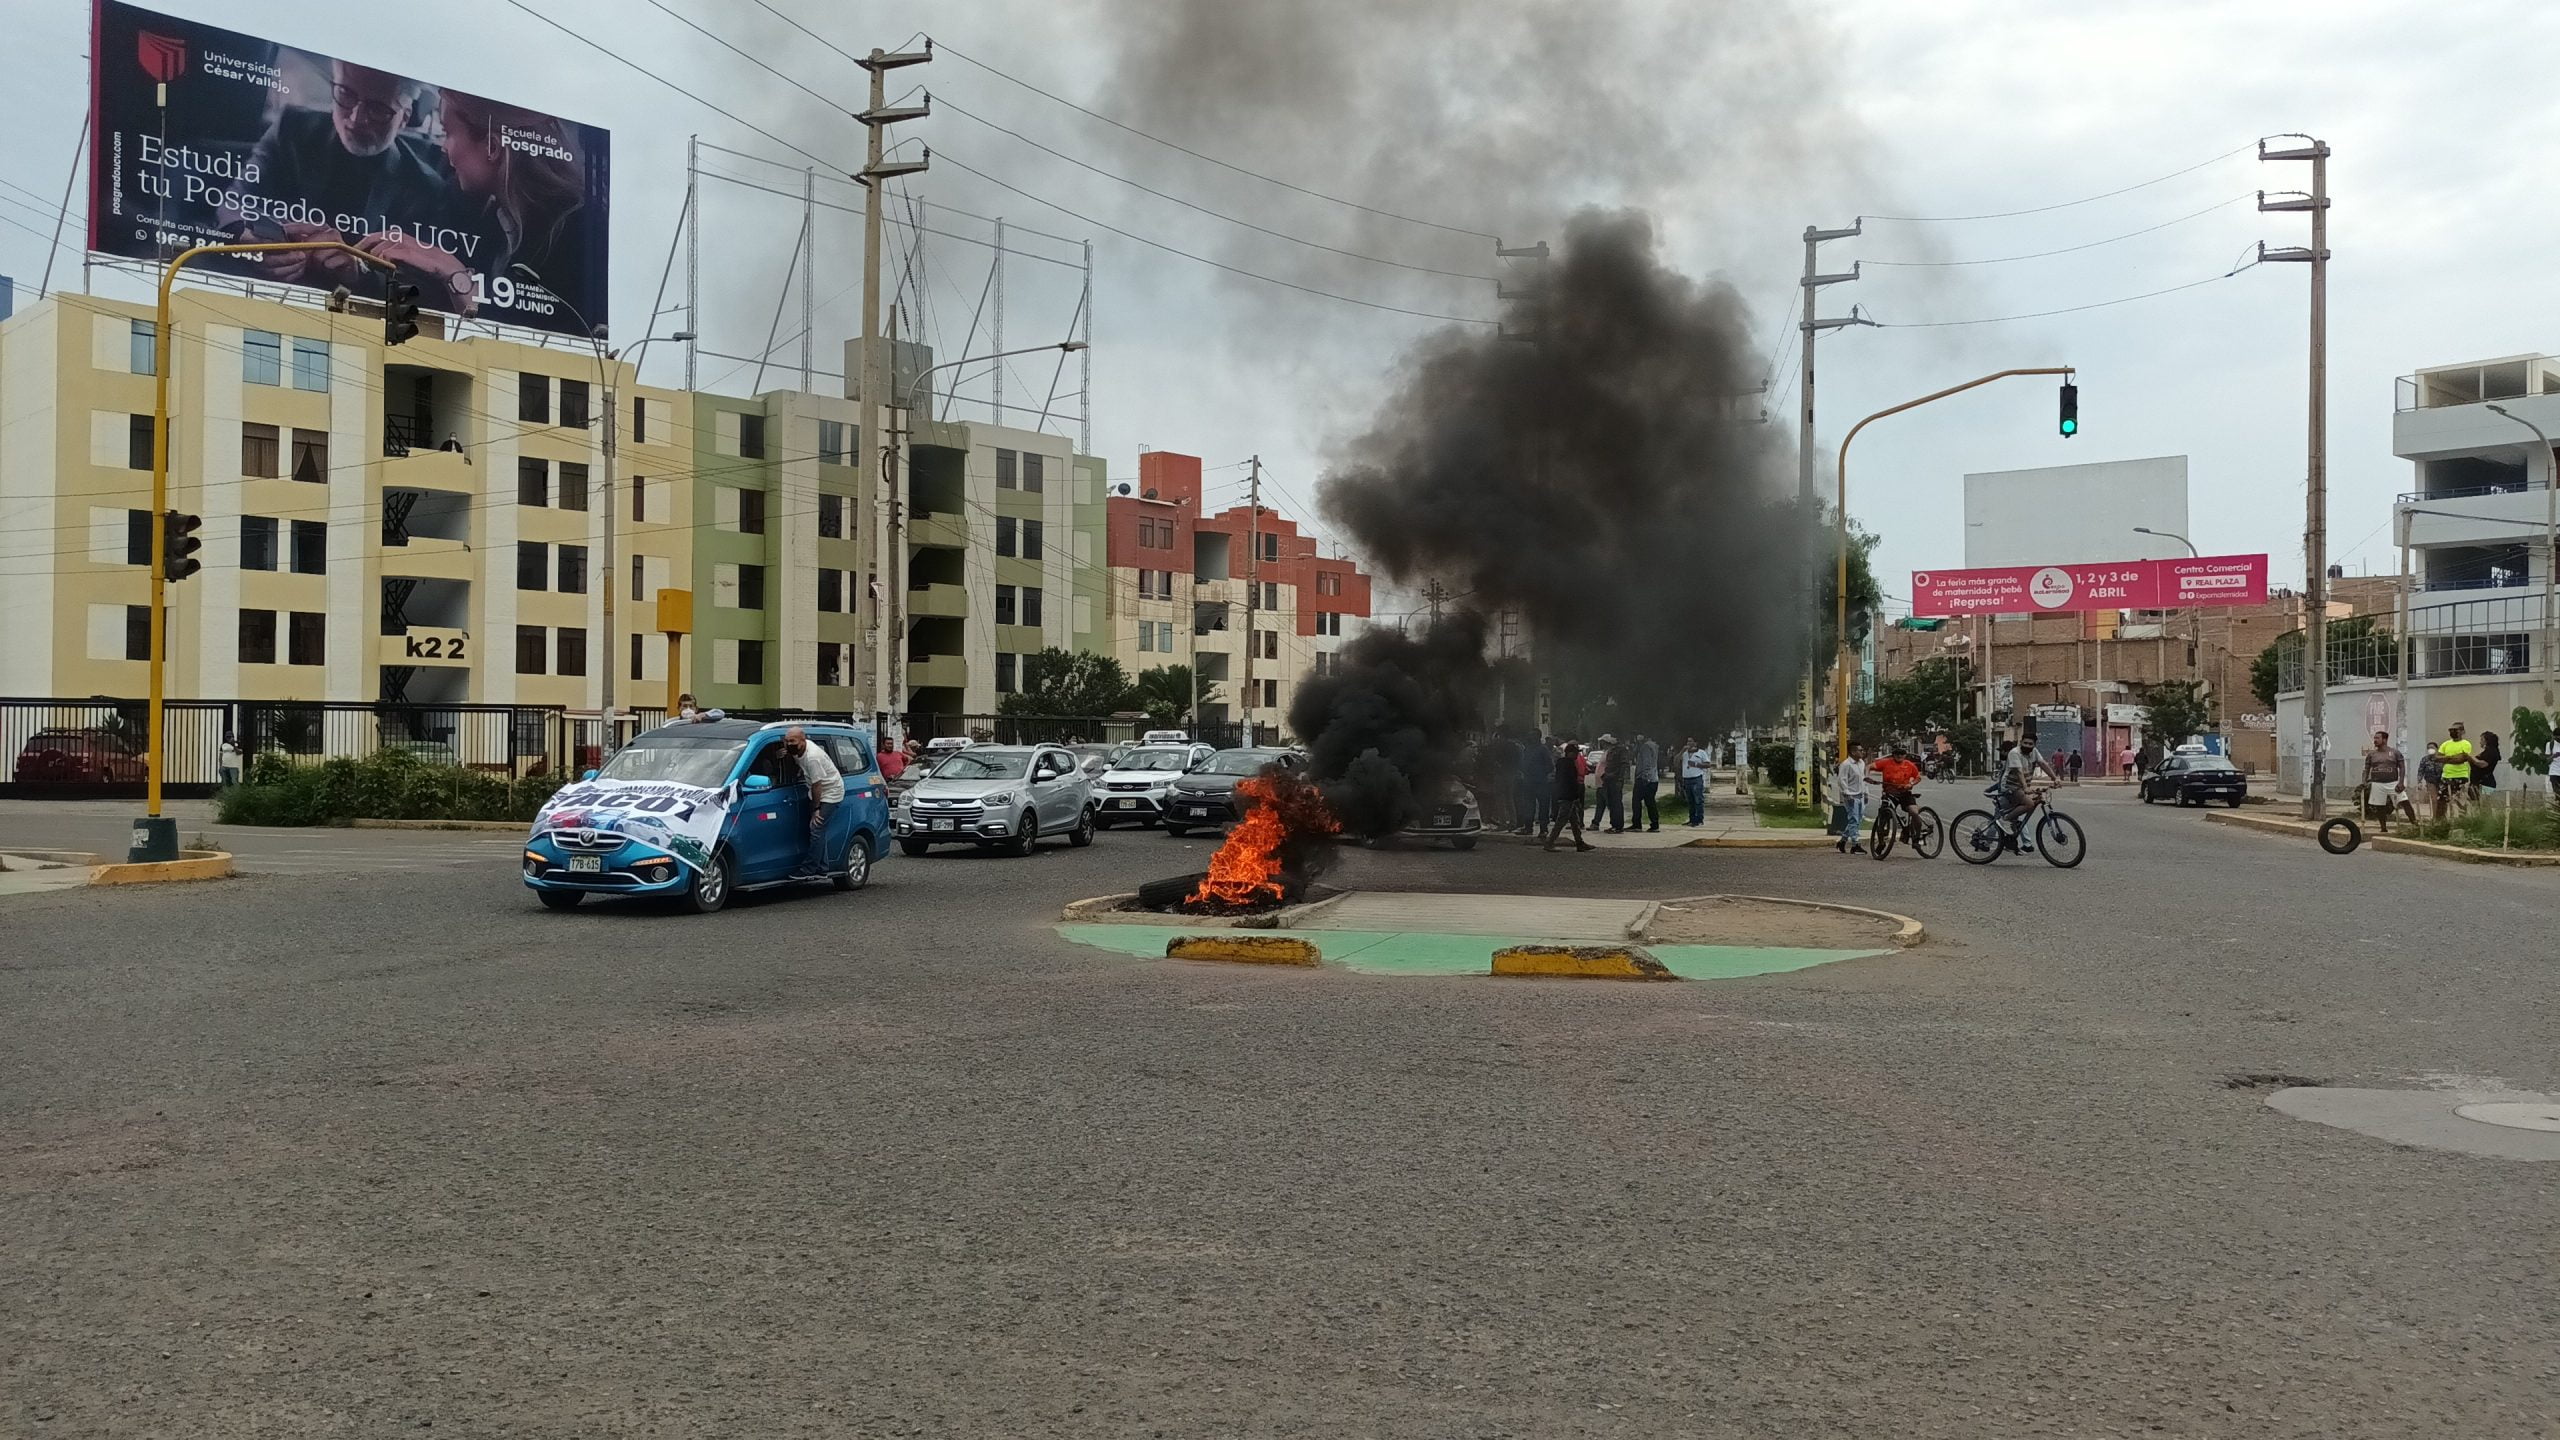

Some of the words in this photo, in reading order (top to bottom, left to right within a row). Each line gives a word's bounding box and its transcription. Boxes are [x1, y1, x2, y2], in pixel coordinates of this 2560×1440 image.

[204, 49, 281, 77] Universidad
[203, 63, 244, 80] César
[246, 73, 290, 94] Vallejo
[501, 124, 542, 142] Escuela
[544, 134, 557, 145] de
[139, 134, 260, 184] Estudia
[501, 135, 573, 162] Posgrado
[112, 131, 122, 215] posgradoucv.com
[137, 169, 172, 198] tu
[183, 174, 326, 226] Posgrado
[335, 212, 370, 237] en
[379, 215, 403, 243] la
[413, 222, 481, 258] UCV
[136, 213, 176, 229] Consulta
[177, 223, 194, 232] con
[195, 225, 204, 234] tu
[206, 228, 235, 239] asesor
[471, 273, 515, 308] 19
[515, 299, 554, 315] JUNIO
[2076, 573, 2085, 585] 1,
[2088, 573, 2096, 583] 2
[2098, 574, 2107, 586] y
[2110, 571, 2118, 582] 3
[2120, 571, 2139, 582] de
[2174, 566, 2204, 574] Centro
[2206, 563, 2252, 573] Comercial
[1932, 589, 1943, 597] de
[1945, 587, 1992, 596] maternidad
[2001, 585, 2023, 593] bebé
[1936, 579, 1946, 587] La
[1948, 578, 1966, 587] feria
[1968, 577, 1986, 585] más
[1987, 575, 2018, 586] grande
[1949, 596, 2004, 609] ¡Regresa!
[2089, 587, 2127, 599] ABRIL
